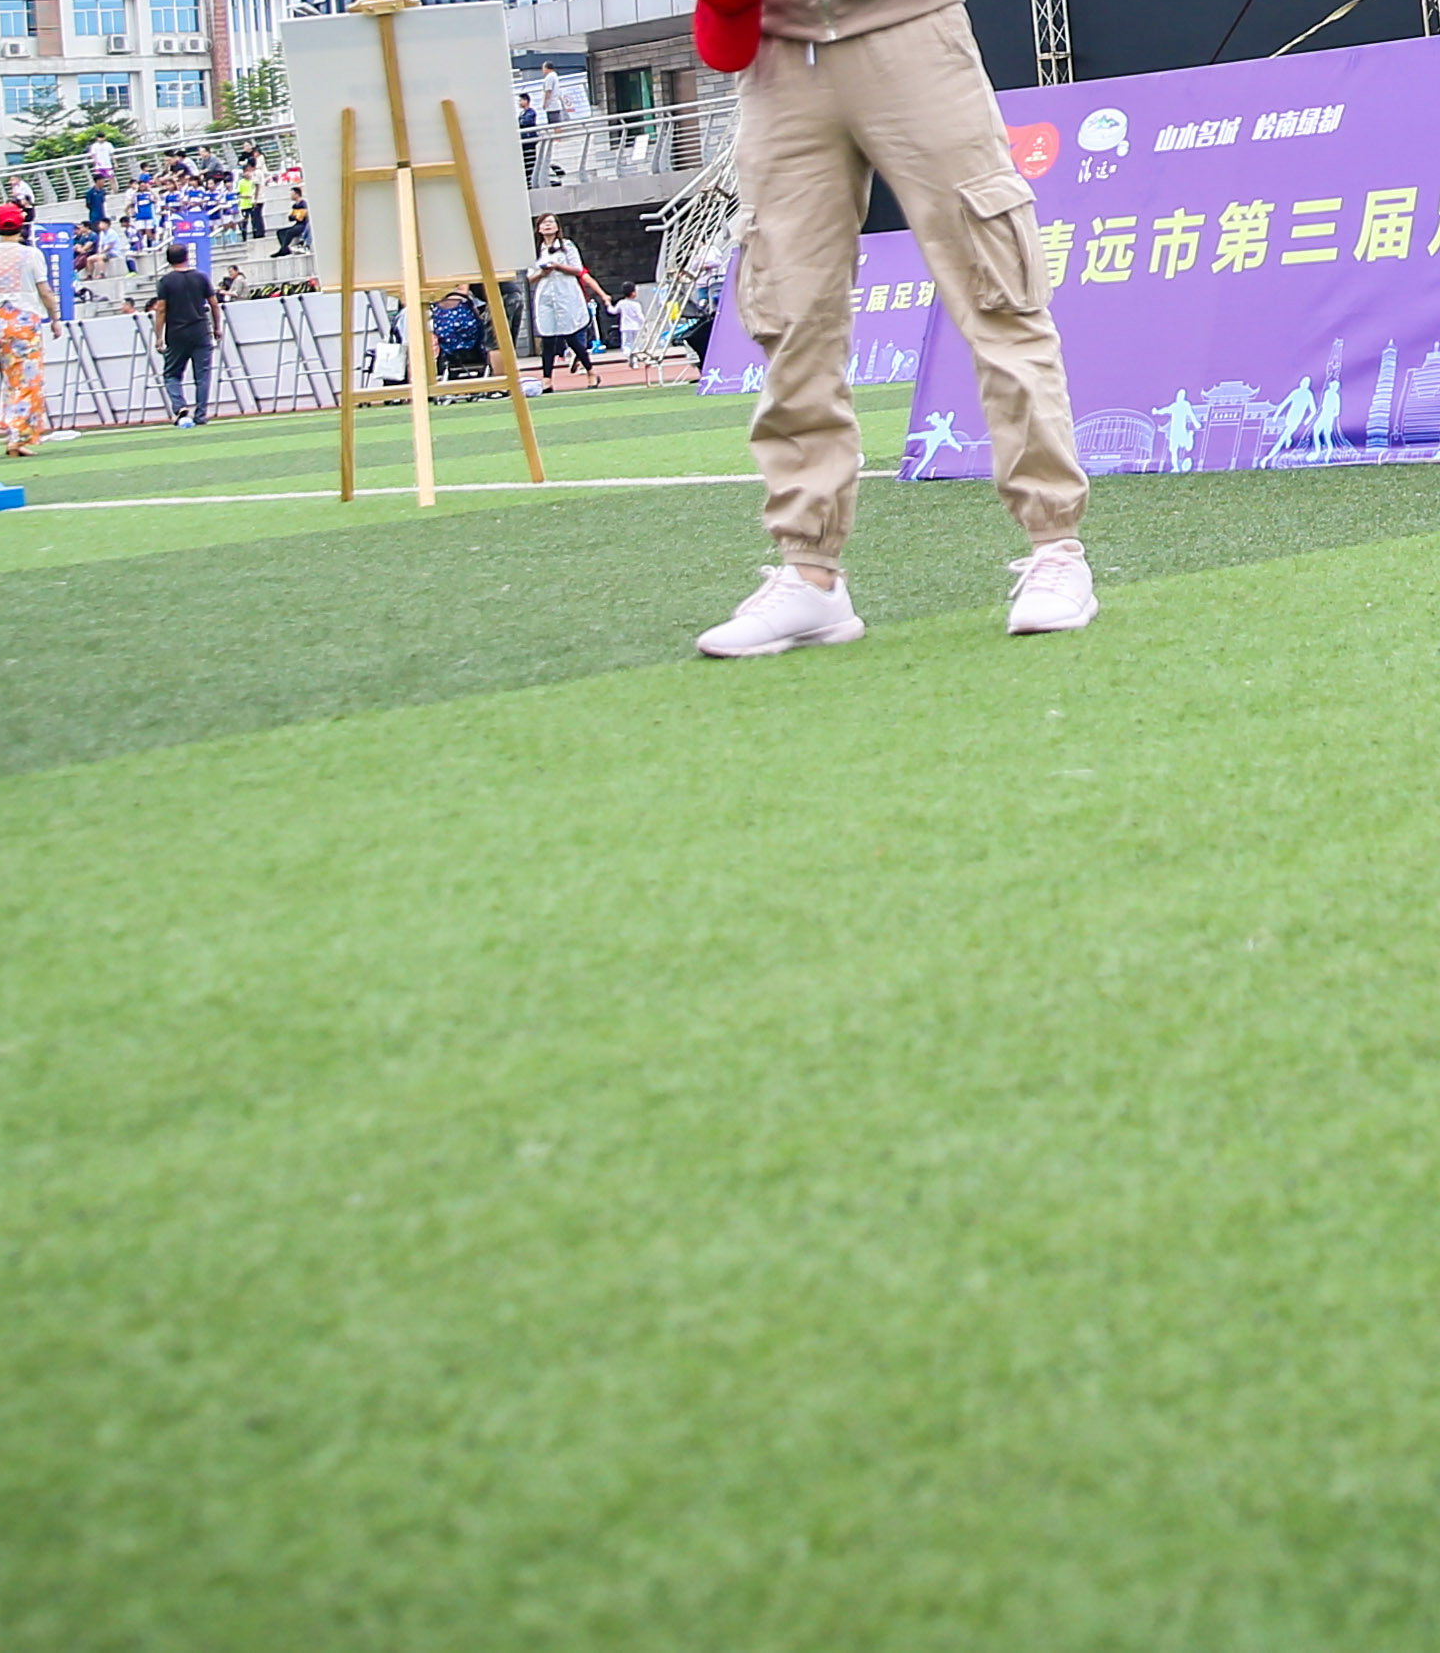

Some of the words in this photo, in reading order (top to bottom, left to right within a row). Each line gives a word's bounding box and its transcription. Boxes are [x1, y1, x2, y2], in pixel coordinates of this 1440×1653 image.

[1153, 116, 1243, 153] 山水名城
[1250, 103, 1346, 141] 岭南绿都
